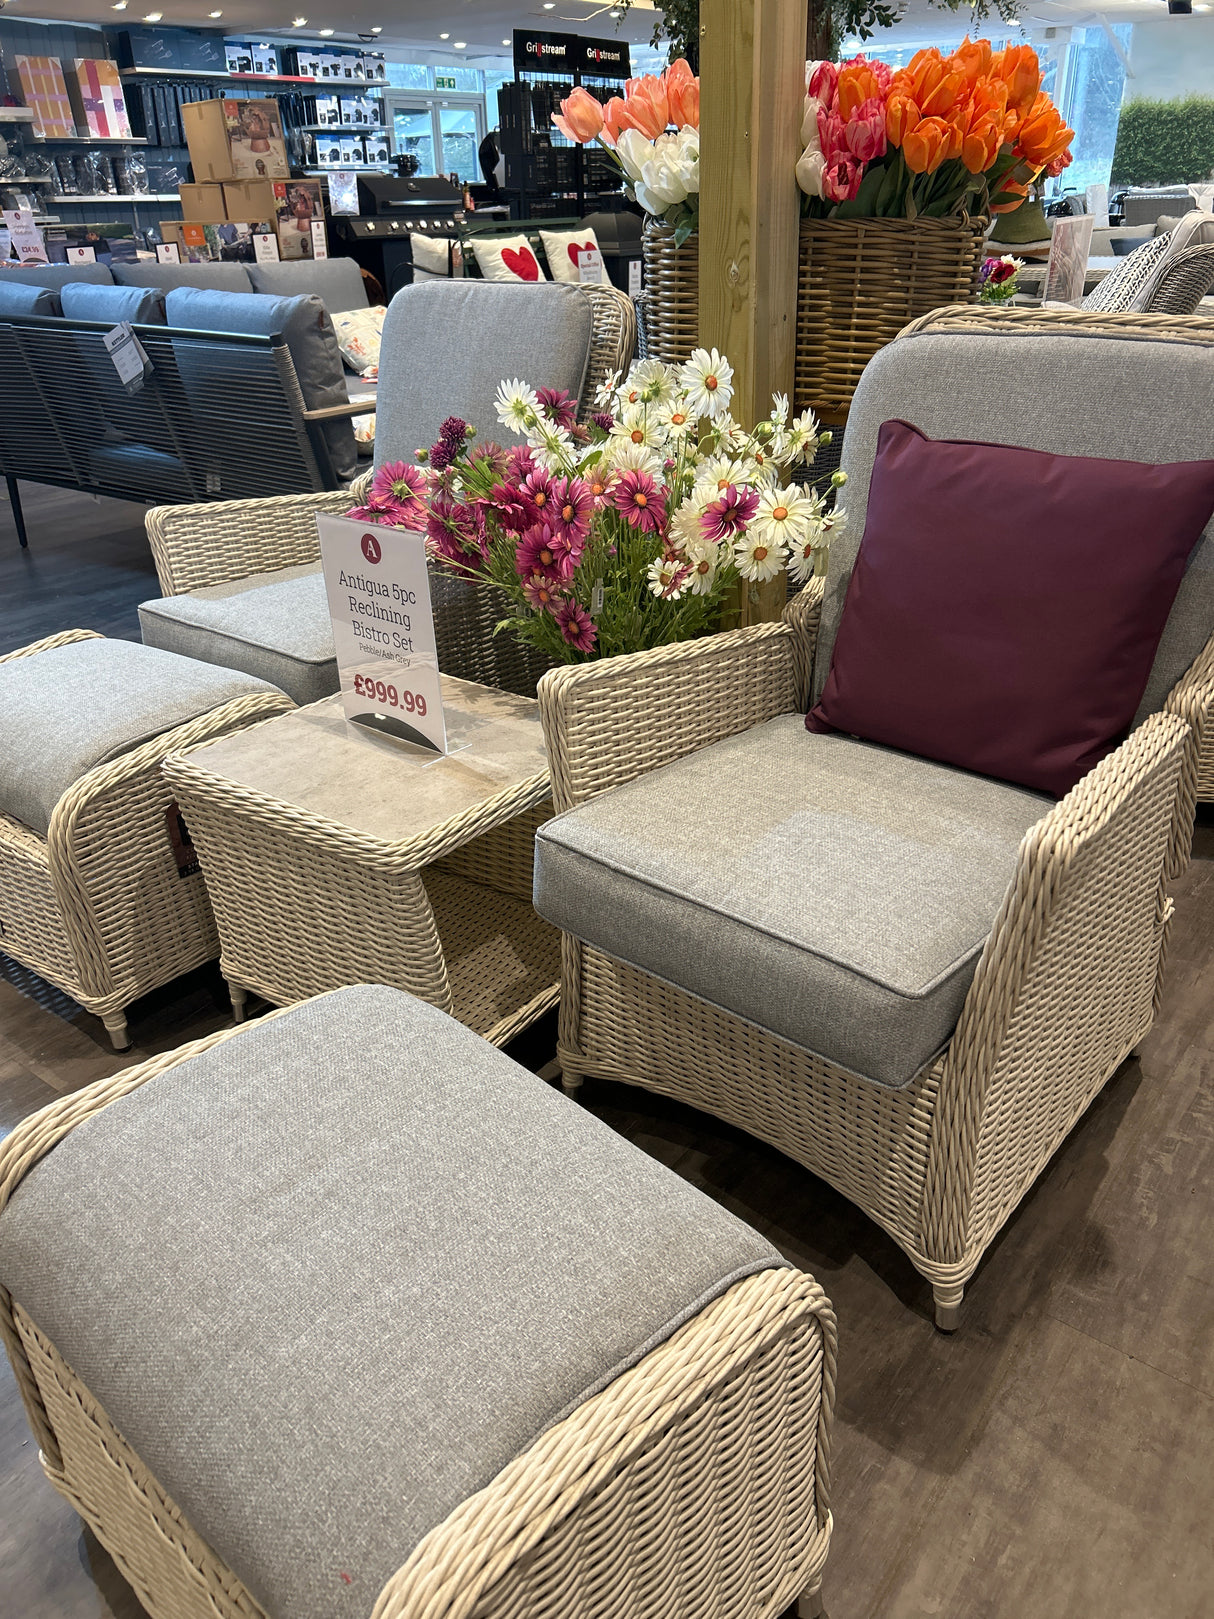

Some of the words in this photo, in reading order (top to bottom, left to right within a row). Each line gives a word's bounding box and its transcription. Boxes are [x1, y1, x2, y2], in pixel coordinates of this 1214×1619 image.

[339, 570, 390, 598] Antigua
[392, 584, 416, 605] 5pc
[348, 596, 411, 631] Reclining
[352, 620, 390, 645] Bistro
[392, 633, 414, 653] Set
[395, 654, 411, 667] Grey
[354, 674, 427, 717] £999.99
